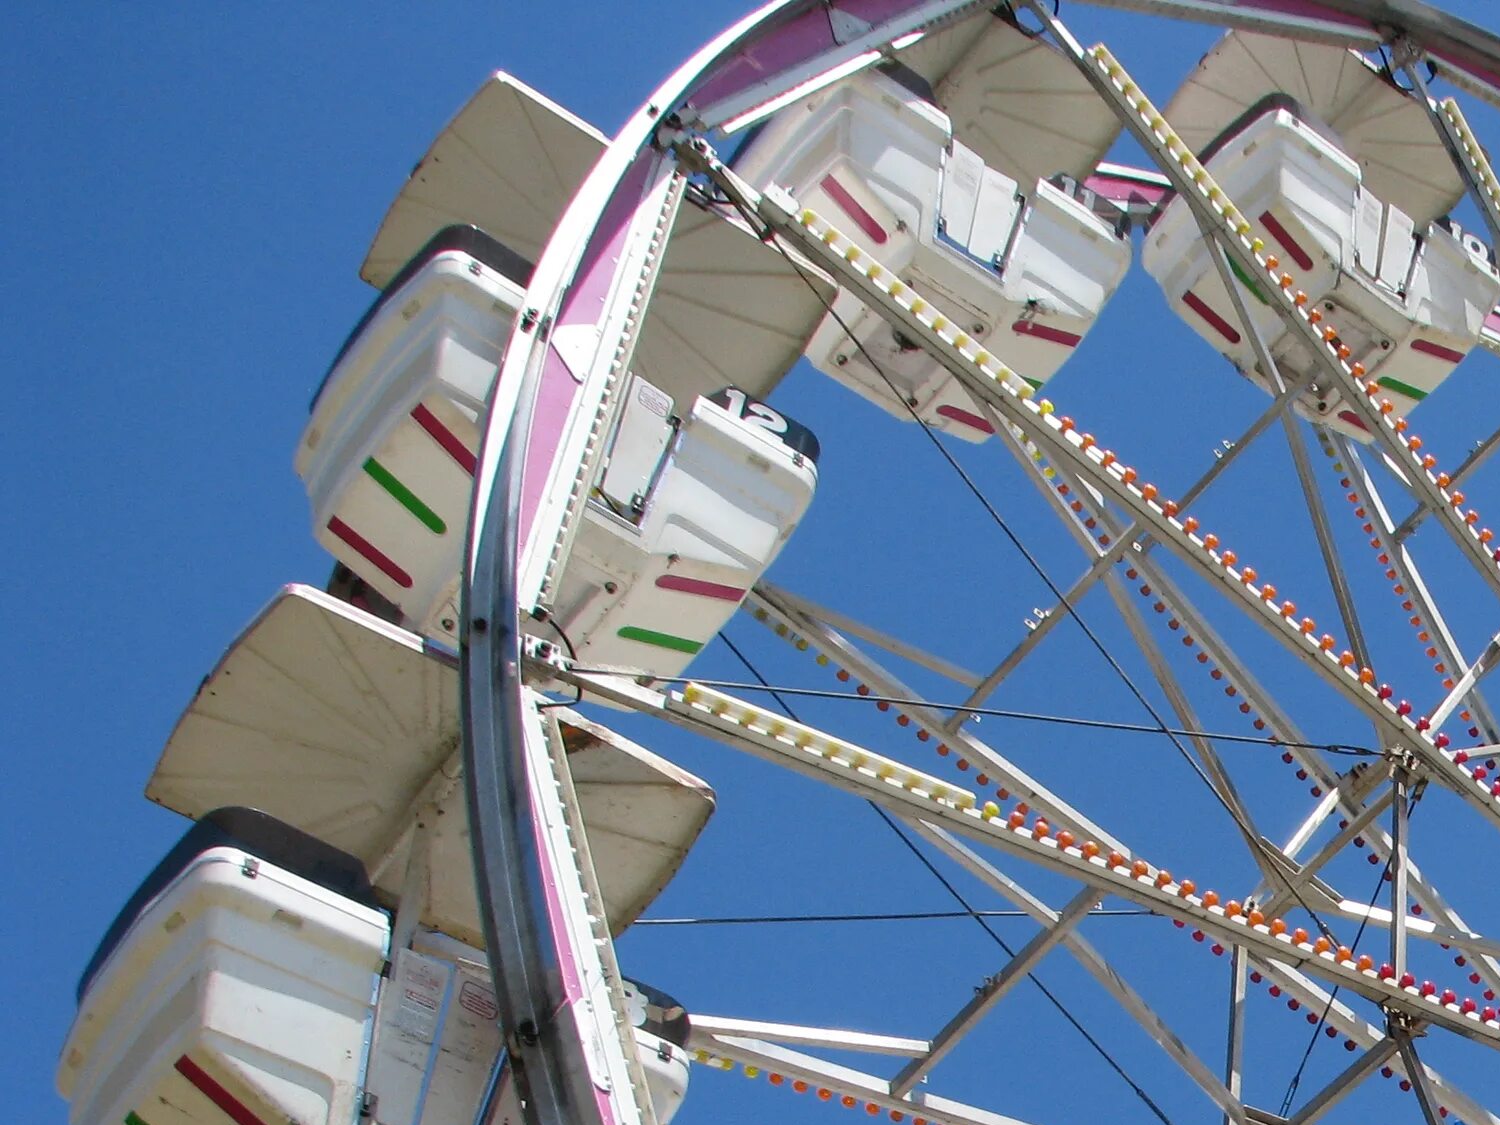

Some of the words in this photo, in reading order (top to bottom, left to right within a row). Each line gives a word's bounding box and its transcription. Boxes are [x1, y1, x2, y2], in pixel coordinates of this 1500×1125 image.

[1061, 176, 1096, 211] 11
[1450, 222, 1488, 262] 10
[725, 388, 788, 442] 12
